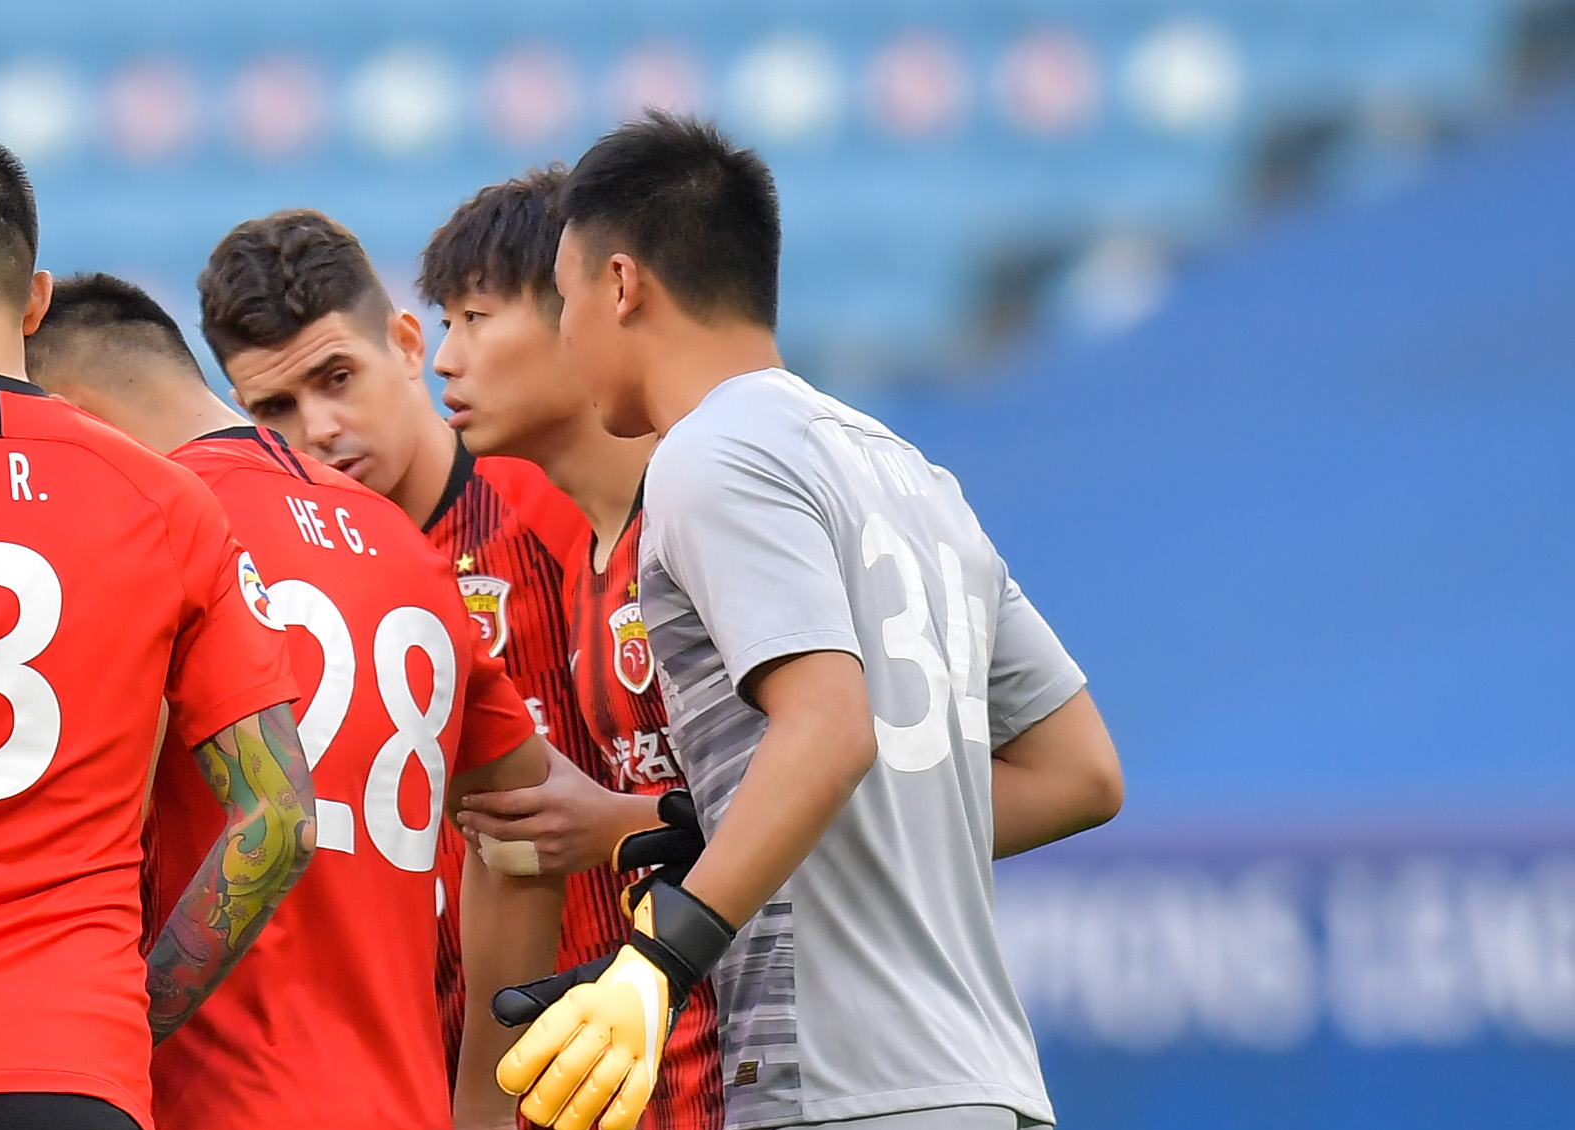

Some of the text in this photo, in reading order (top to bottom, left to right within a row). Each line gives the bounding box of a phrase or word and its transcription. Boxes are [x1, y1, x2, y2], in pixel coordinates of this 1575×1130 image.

[8, 451, 49, 501] R.
[285, 495, 378, 556] HE G.
[266, 578, 457, 873] 28
